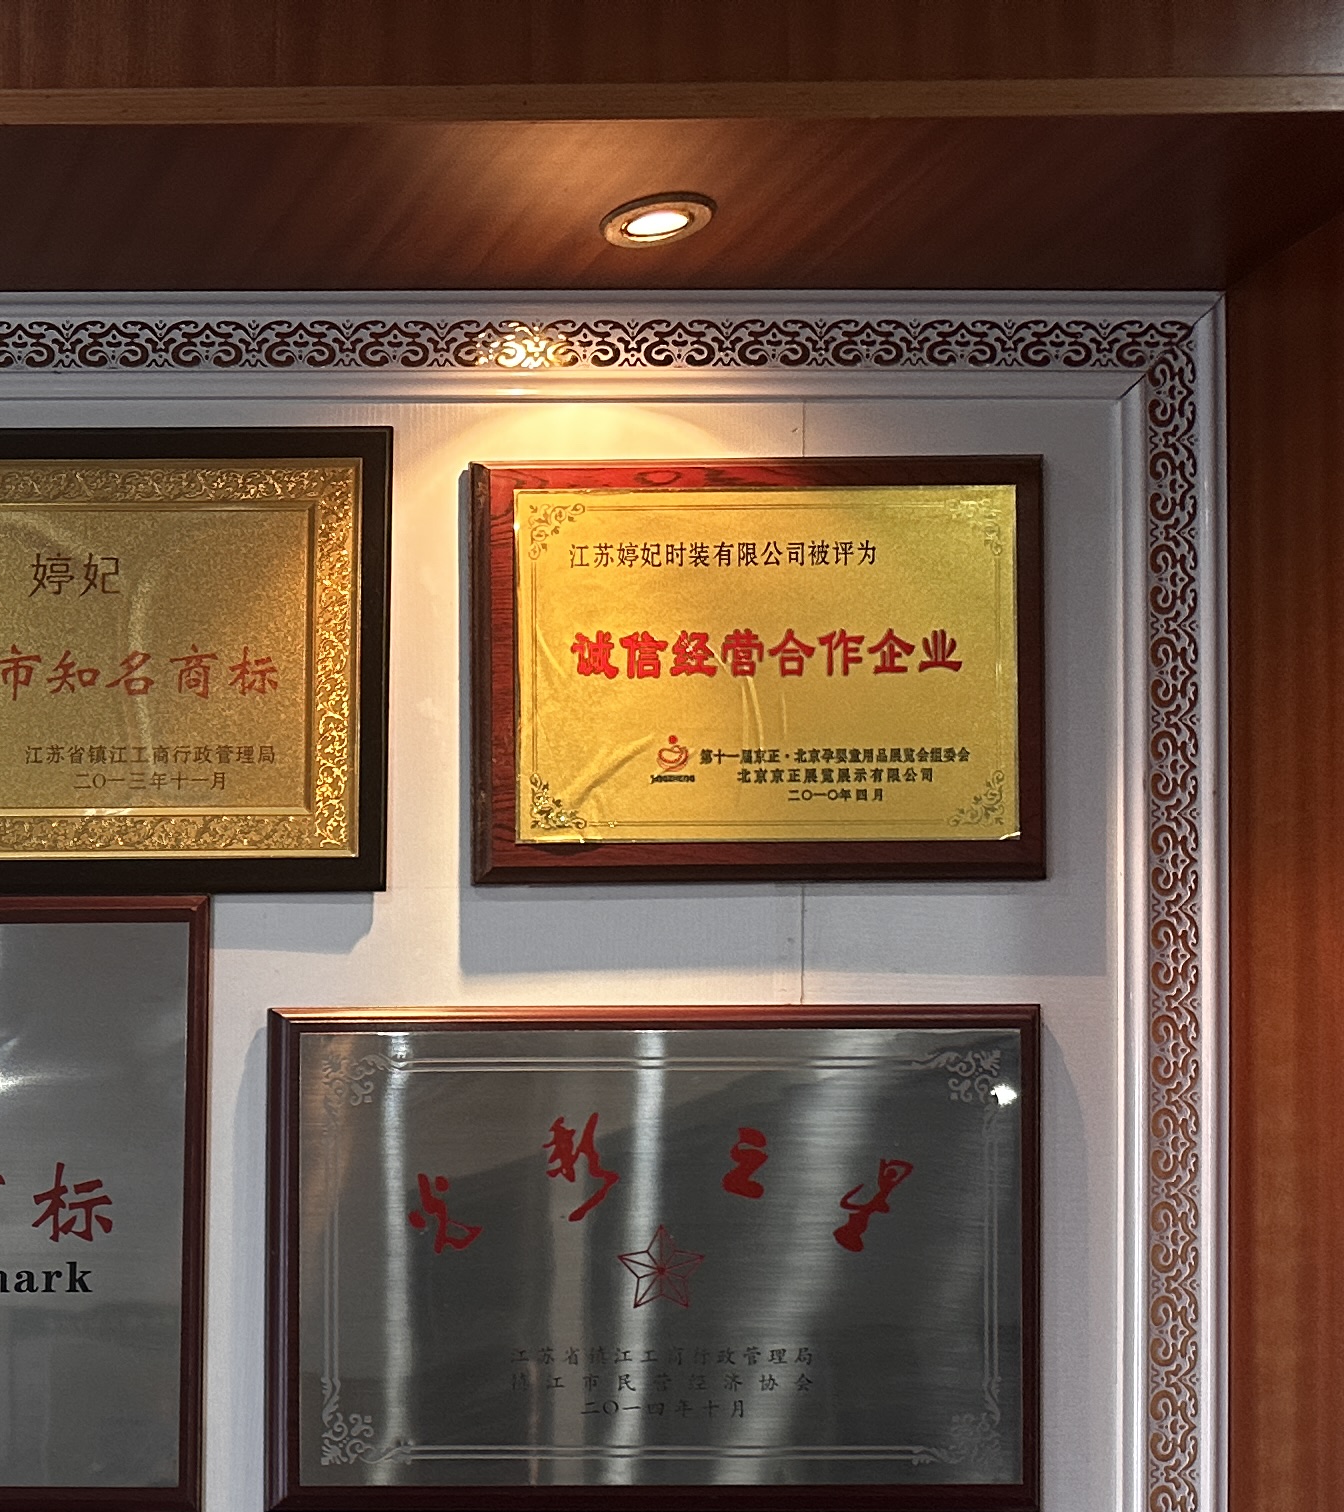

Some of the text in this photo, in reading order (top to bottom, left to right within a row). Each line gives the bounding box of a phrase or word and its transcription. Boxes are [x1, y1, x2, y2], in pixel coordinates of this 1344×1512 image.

[569, 540, 878, 569] 江苏婷妃时装有限公司被评为
[29, 552, 122, 598] 婷妃
[570, 628, 964, 680] 诚信经营合作企业
[25, 745, 276, 766] 江苏省镇江工商行政管理局
[737, 768, 935, 783] 北京京正展览展示有限公司
[511, 1346, 813, 1368] 江苏省镇江工商行政管理局
